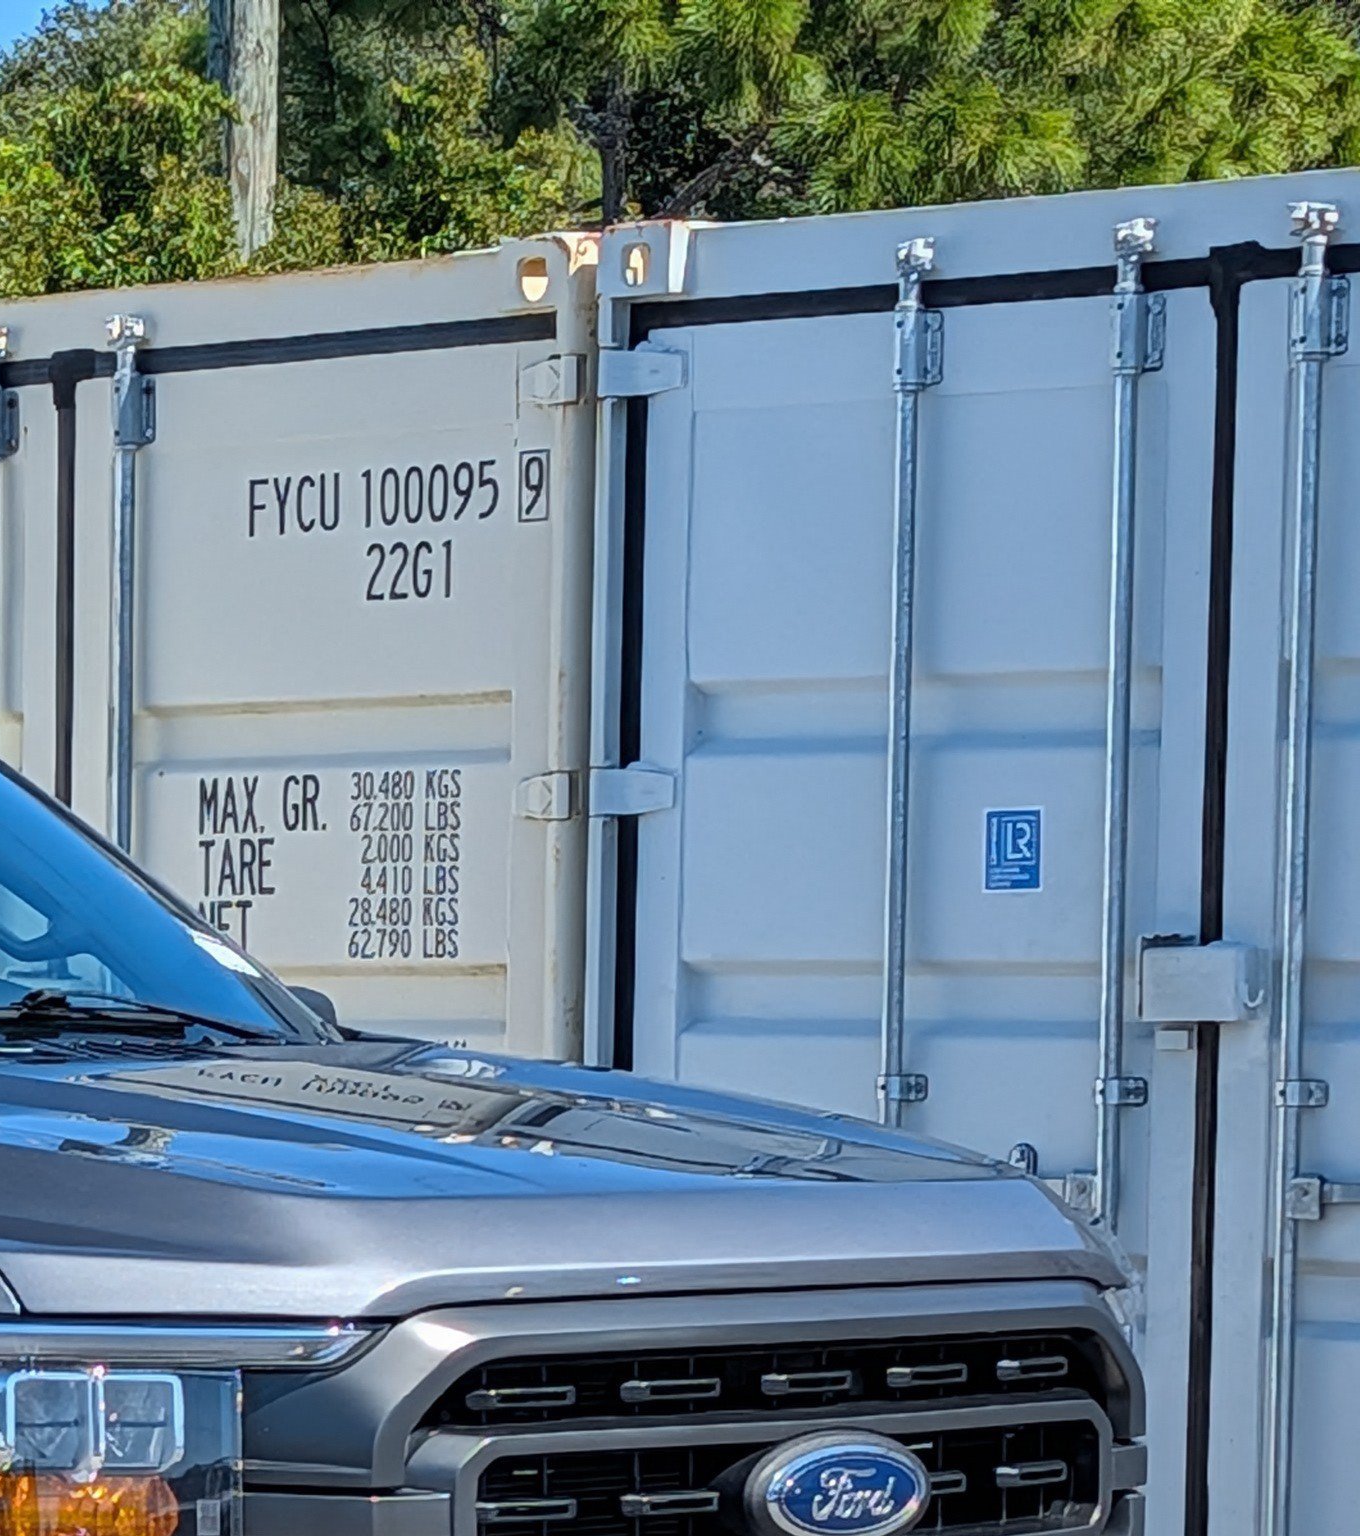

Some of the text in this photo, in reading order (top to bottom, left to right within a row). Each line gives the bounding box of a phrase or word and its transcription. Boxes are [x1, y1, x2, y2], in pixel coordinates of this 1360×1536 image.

[248, 453, 546, 538] FYCU 100095 9
[365, 538, 454, 602] 22G1
[424, 768, 463, 800] KGS
[282, 773, 328, 832] GR.
[424, 800, 462, 832] LBS
[423, 832, 461, 864] KGS
[198, 837, 277, 897] TARE
[423, 864, 460, 896] LBS
[422, 896, 460, 927] KGS
[422, 928, 460, 959] LBS
[811, 1465, 896, 1522] Ford
